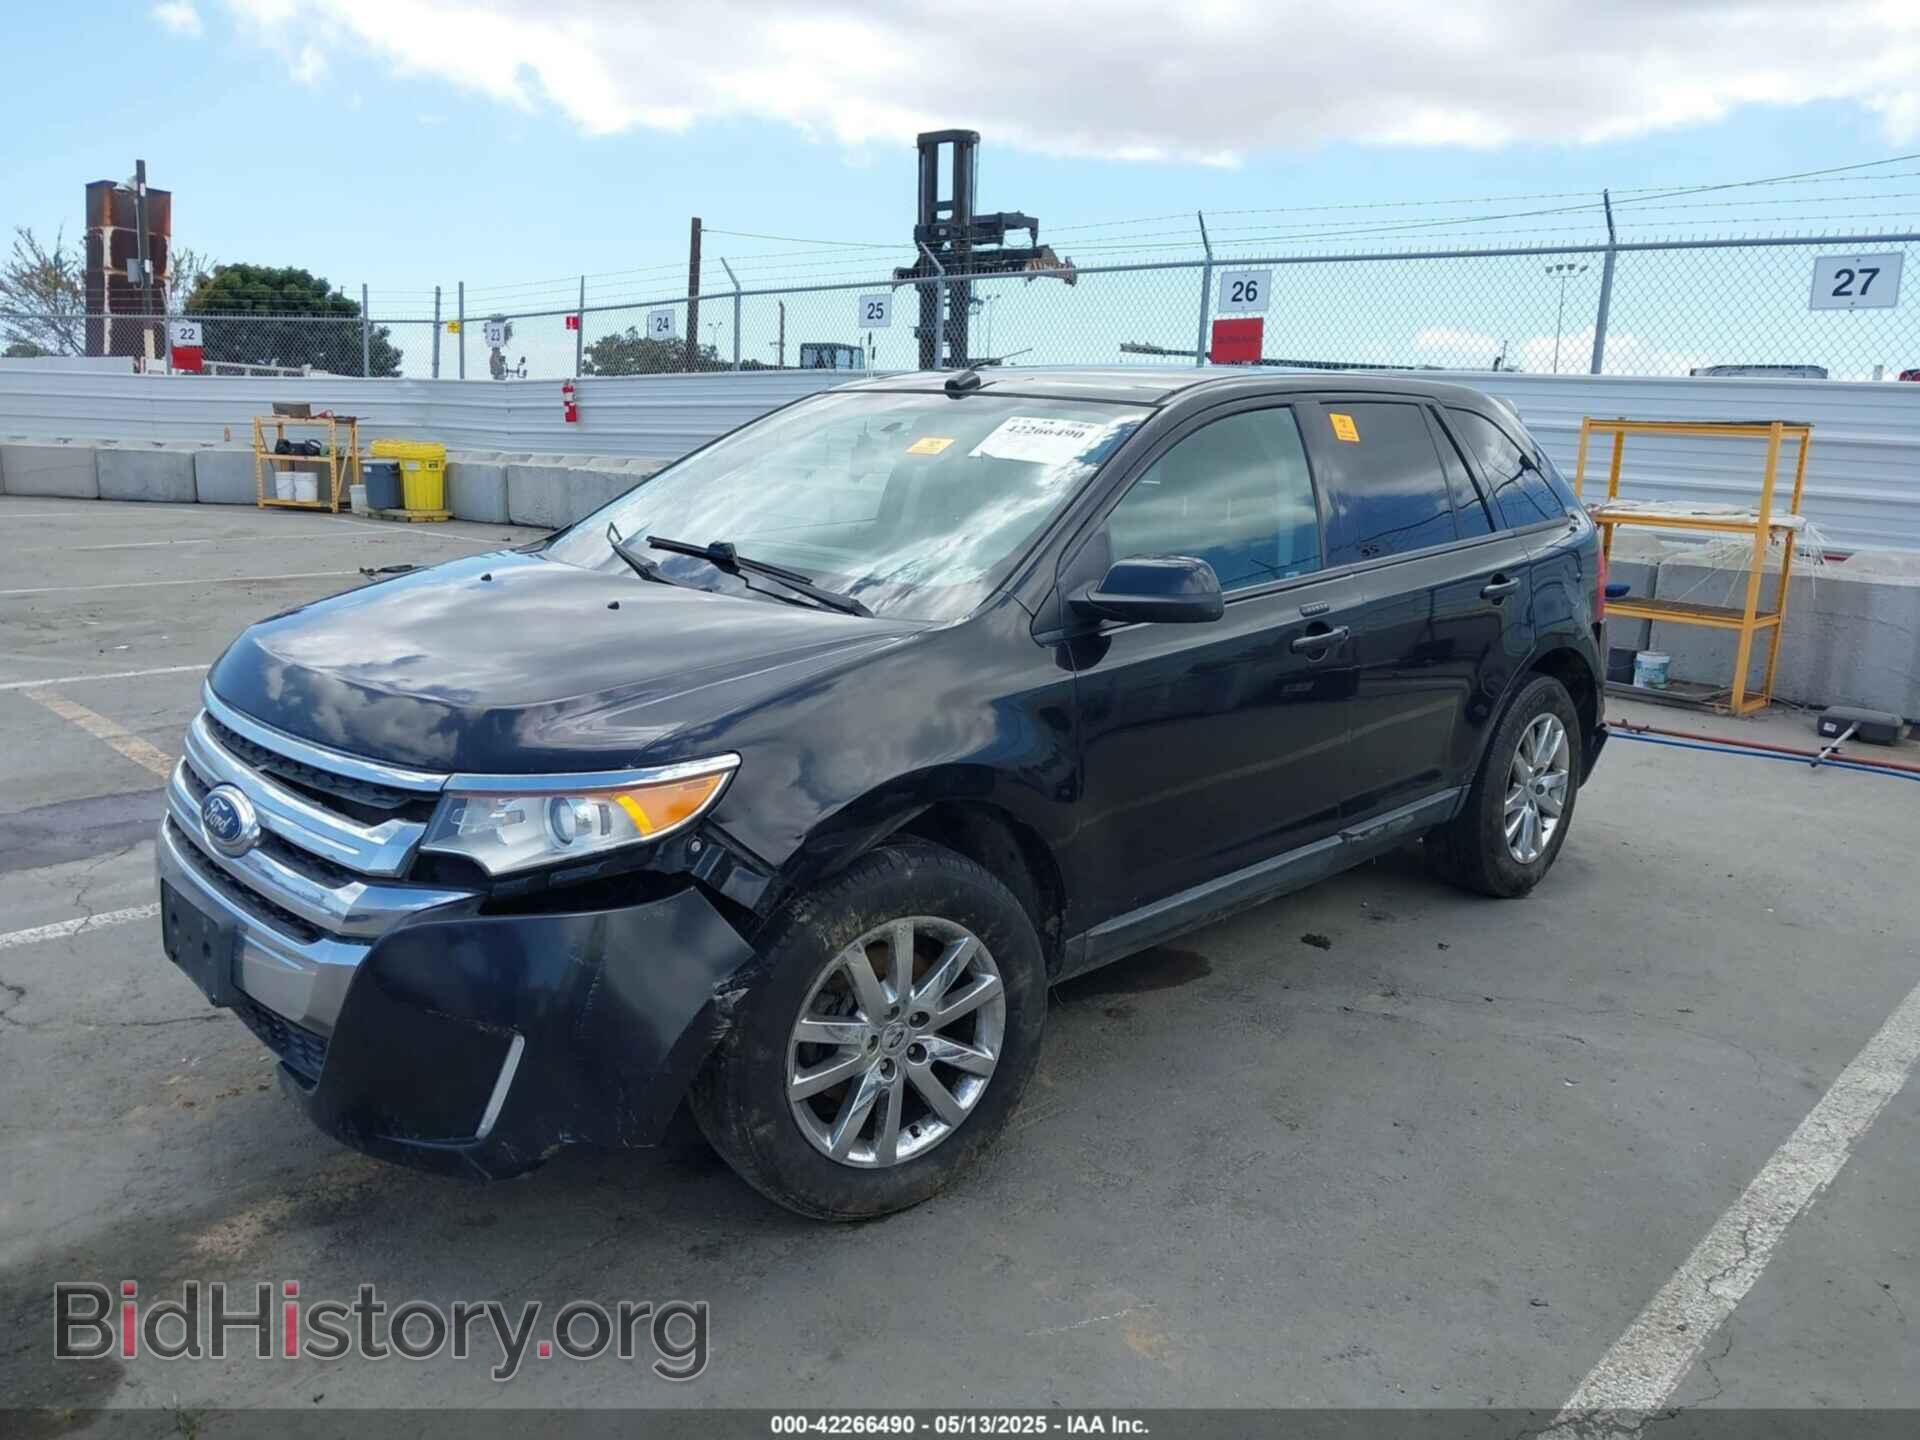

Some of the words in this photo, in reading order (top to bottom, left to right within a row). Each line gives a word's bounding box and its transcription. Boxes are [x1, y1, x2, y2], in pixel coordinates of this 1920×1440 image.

[1231, 280, 1258, 302] 26
[1831, 267, 1880, 296] 27
[867, 302, 884, 319] 25
[179, 328, 195, 340] 22
[656, 317, 669, 332] 24
[205, 797, 232, 833] Ford
